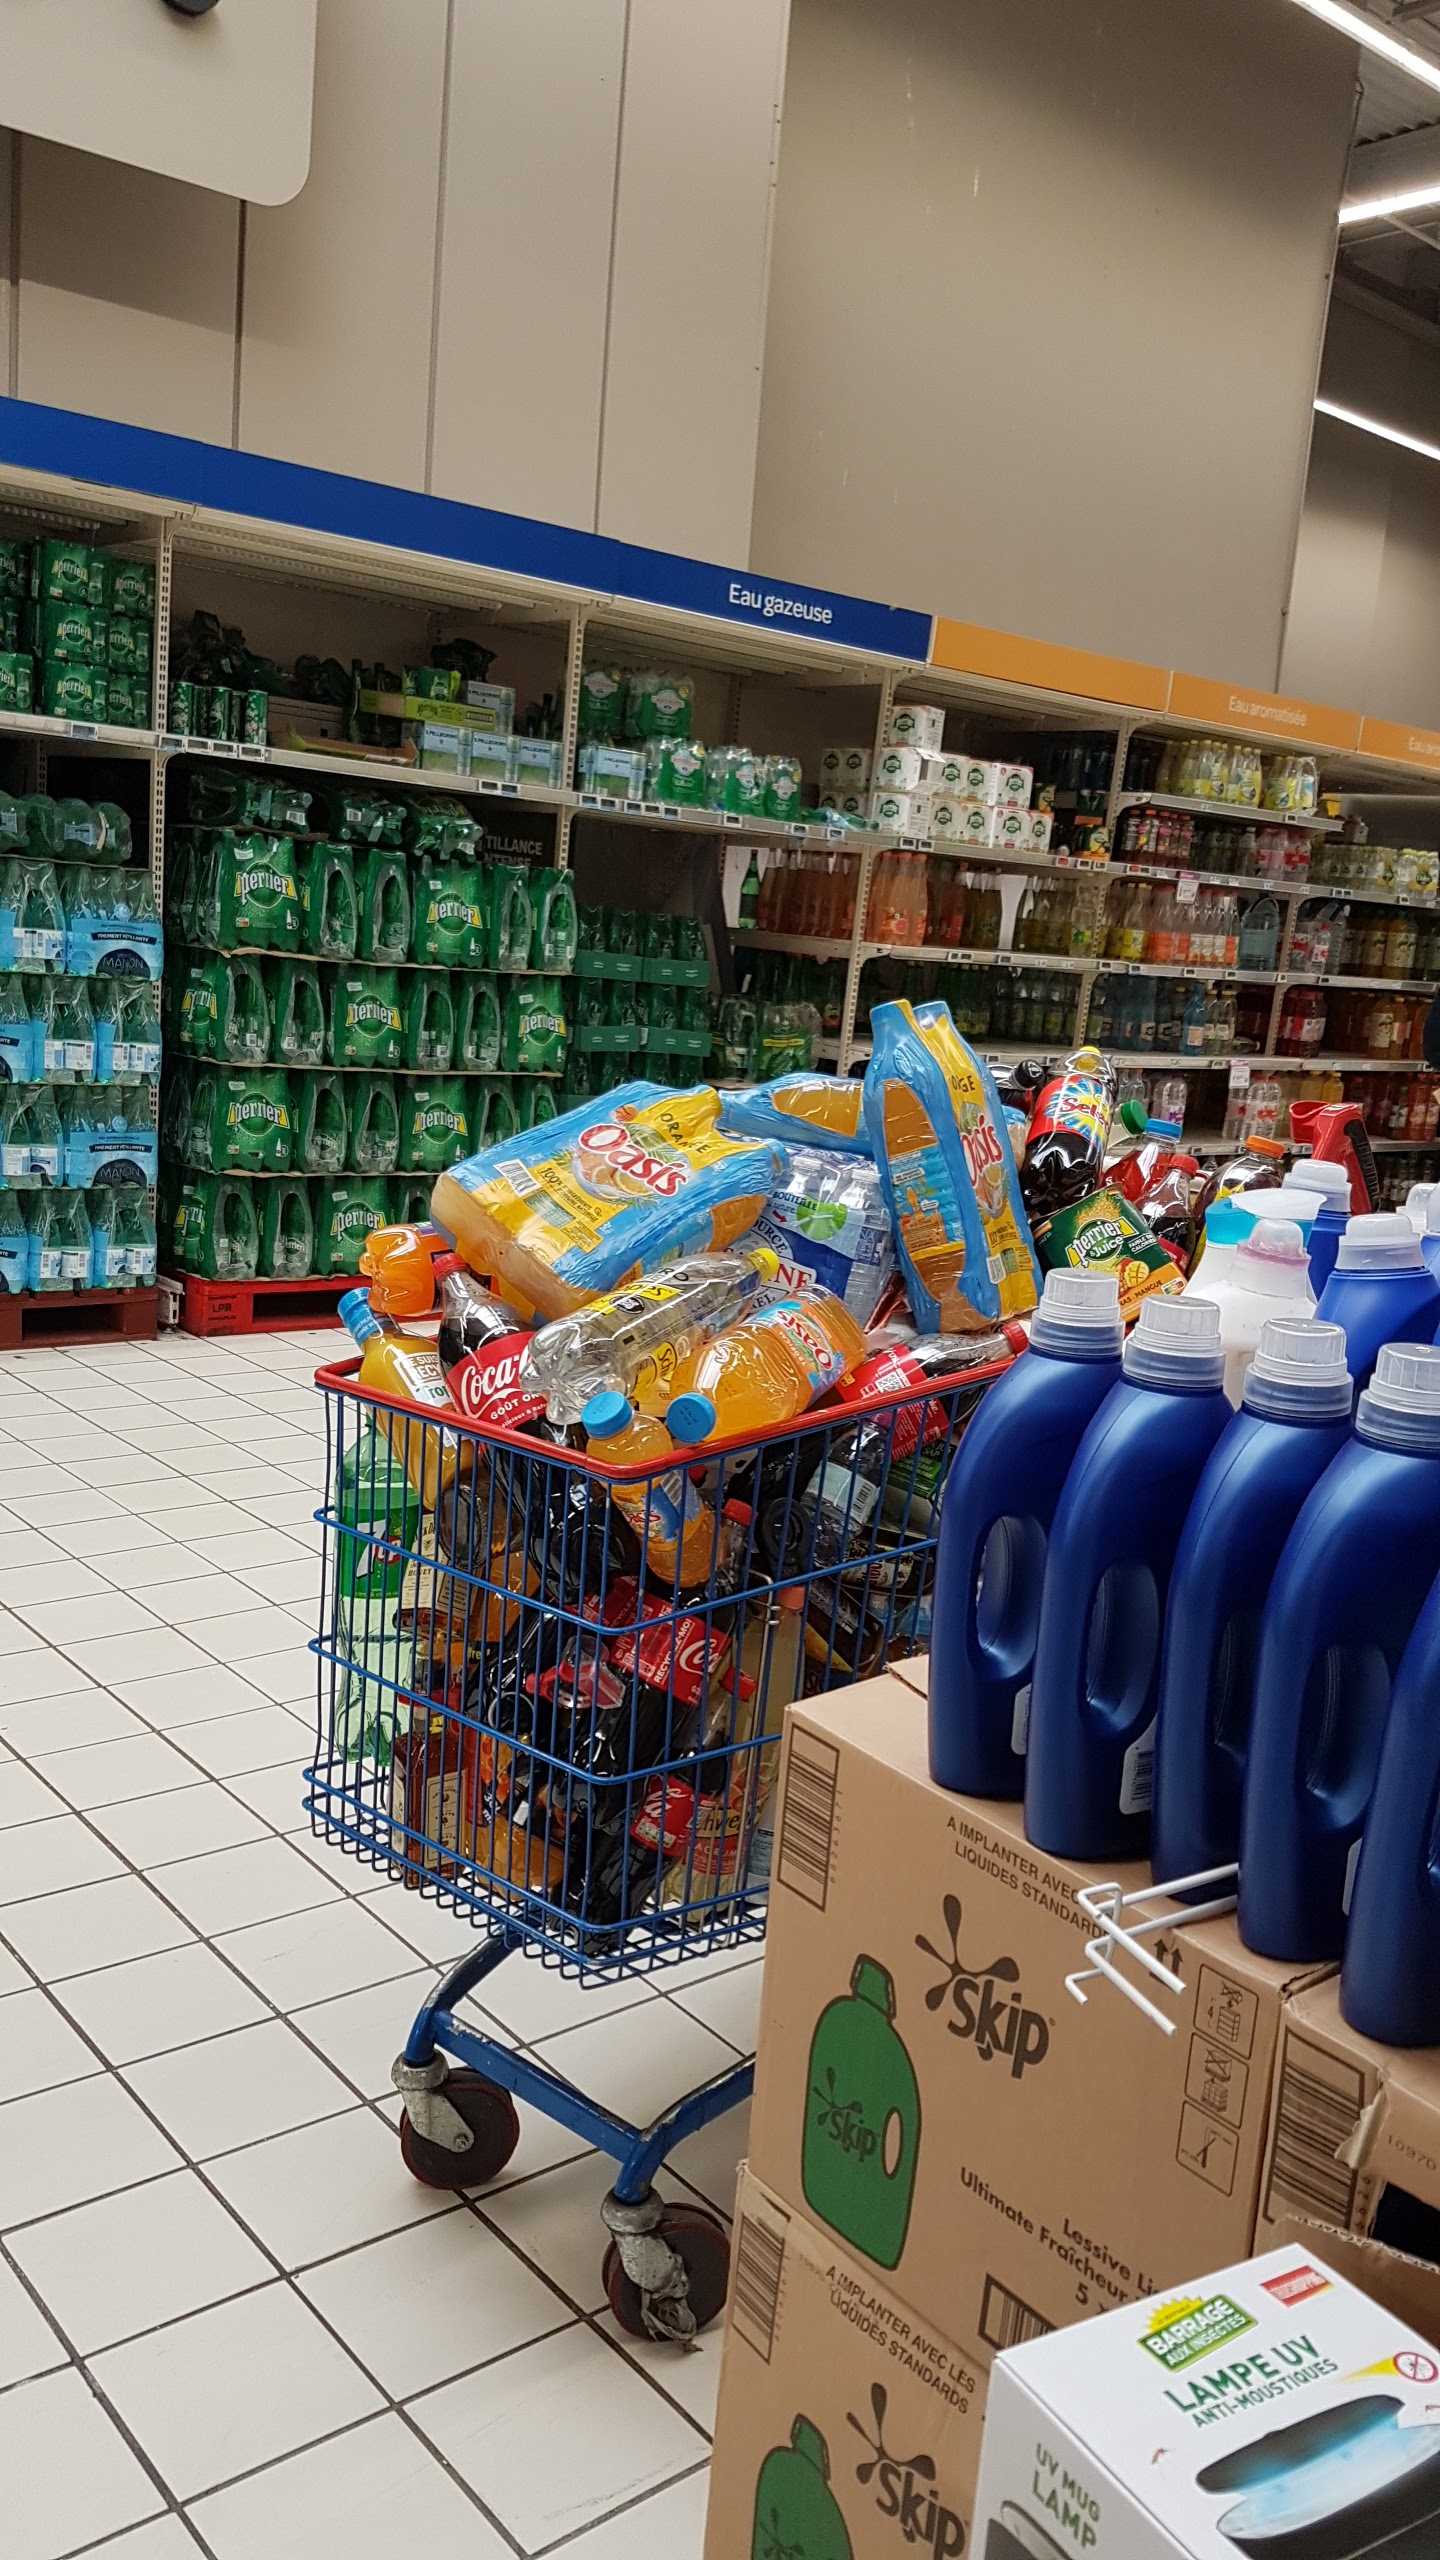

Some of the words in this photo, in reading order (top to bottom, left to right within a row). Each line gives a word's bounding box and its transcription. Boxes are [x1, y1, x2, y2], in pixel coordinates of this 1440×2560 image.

[57, 560, 87, 580] perrier
[729, 583, 761, 609] Eau
[763, 595, 833, 625] gazeuse
[62, 623, 90, 641] perrier
[109, 633, 133, 649] errier
[61, 681, 90, 699] perrier
[109, 691, 130, 708] errier
[1228, 695, 1250, 714] Eau
[1250, 703, 1308, 728] aromatisée
[478, 834, 544, 857] TILLANCE
[240, 869, 289, 906] perrier
[234, 1099, 283, 1133] perrier
[578, 1123, 690, 1197] Oasis
[962, 1113, 1003, 1187] Oasis
[335, 1208, 381, 1241] perrier
[1072, 1218, 1123, 1267] perrier
[766, 1263, 813, 1289] NE
[1135, 1280, 1165, 1301] MANGUE
[418, 1354, 438, 1366] SUIS
[776, 1310, 833, 1371] Oasis
[777, 1330, 807, 1367] TROPICAL
[411, 1364, 440, 1381] RECY
[490, 1398, 520, 1420] GOÛT
[521, 1389, 541, 1403] OR
[946, 1816, 957, 1832] A
[959, 1822, 1039, 1881] IMPLANTER
[1041, 1872, 1081, 1906] AVEC
[954, 1840, 1019, 1891] LIQUIDES
[1021, 1881, 1110, 1940] STANDARD
[947, 1977, 1050, 2080] Skip
[827, 2109, 878, 2163] Skip
[959, 2165, 1034, 2236] Ultimate
[1038, 2225, 1129, 2304] Fraîcheur
[1062, 2217, 1132, 2281] Lessive
[1074, 2281, 1090, 2307] 5
[825, 2264, 837, 2281] A
[836, 2271, 913, 2344] IMPLANTER
[910, 2333, 949, 2371] AVEC
[948, 2361, 977, 2395] LES
[829, 2284, 889, 2348] LIQUIDES
[887, 2339, 970, 2415] STANDARDS
[1146, 2298, 1235, 2357] BARRAGE
[1165, 2341, 1194, 2367] AUX
[1189, 2313, 1248, 2352] INSECTES
[1163, 2353, 1281, 2415] LAMPE
[1270, 2334, 1321, 2370] UV
[1189, 2358, 1339, 2429] ANTI-MOUSTIQUES
[1035, 2443, 1059, 2476] UV
[1061, 2470, 1100, 2522] MUG
[875, 2461, 966, 2560] Skip
[1031, 2470, 1098, 2549] LAMP
